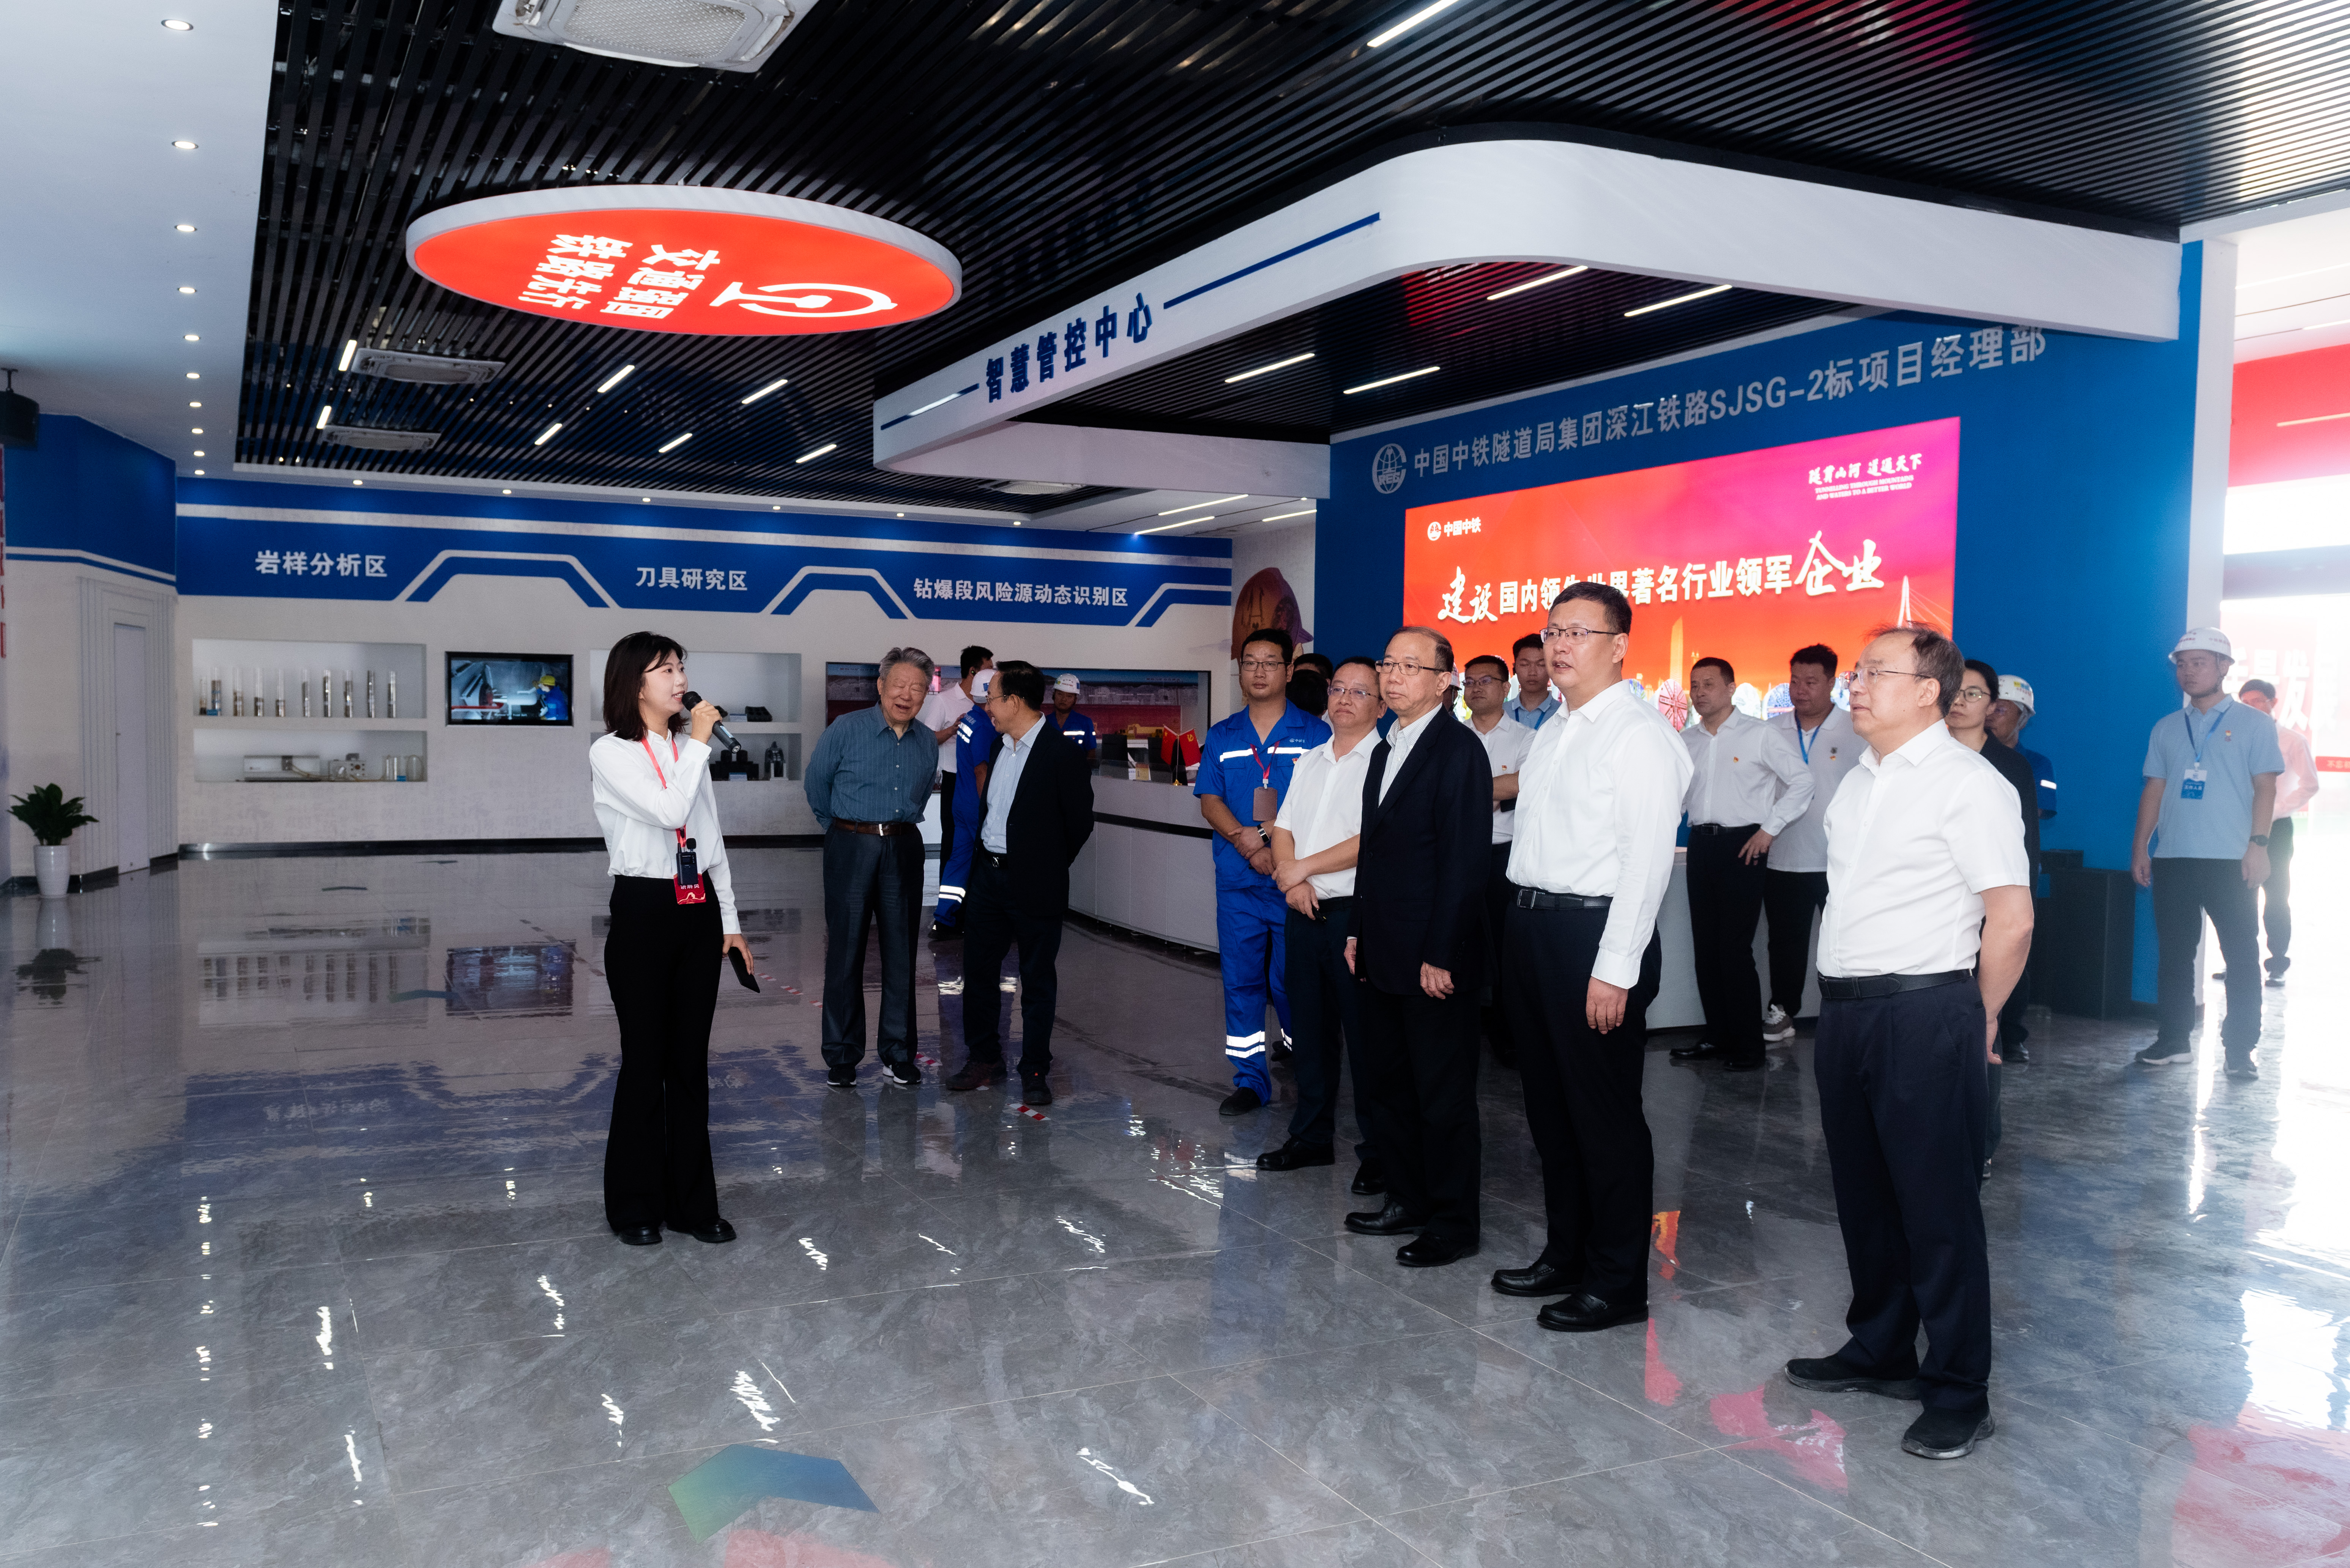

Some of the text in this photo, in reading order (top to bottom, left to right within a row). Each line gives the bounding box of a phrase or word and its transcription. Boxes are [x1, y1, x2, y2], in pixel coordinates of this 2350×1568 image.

[518, 234, 634, 309] 铁路先行
[600, 244, 721, 319] 交通强国
[986, 293, 1152, 403] 智慧管控中心
[1414, 325, 2046, 477] 中国中铁隧道局集团深江铁路SJSG-2标项目经理部
[1829, 490, 1852, 499] WATERS
[1866, 485, 1889, 494] BETTER
[1890, 482, 1912, 491] WORLD
[1850, 480, 1879, 489] THROUGH
[1879, 475, 1914, 485] MOUNTAINS
[1444, 517, 1481, 537] 中国中铁
[255, 550, 388, 577] 岩样分析区
[636, 567, 748, 591] 刀具研究区
[913, 578, 1128, 607] 钻爆段风险源动态识别区
